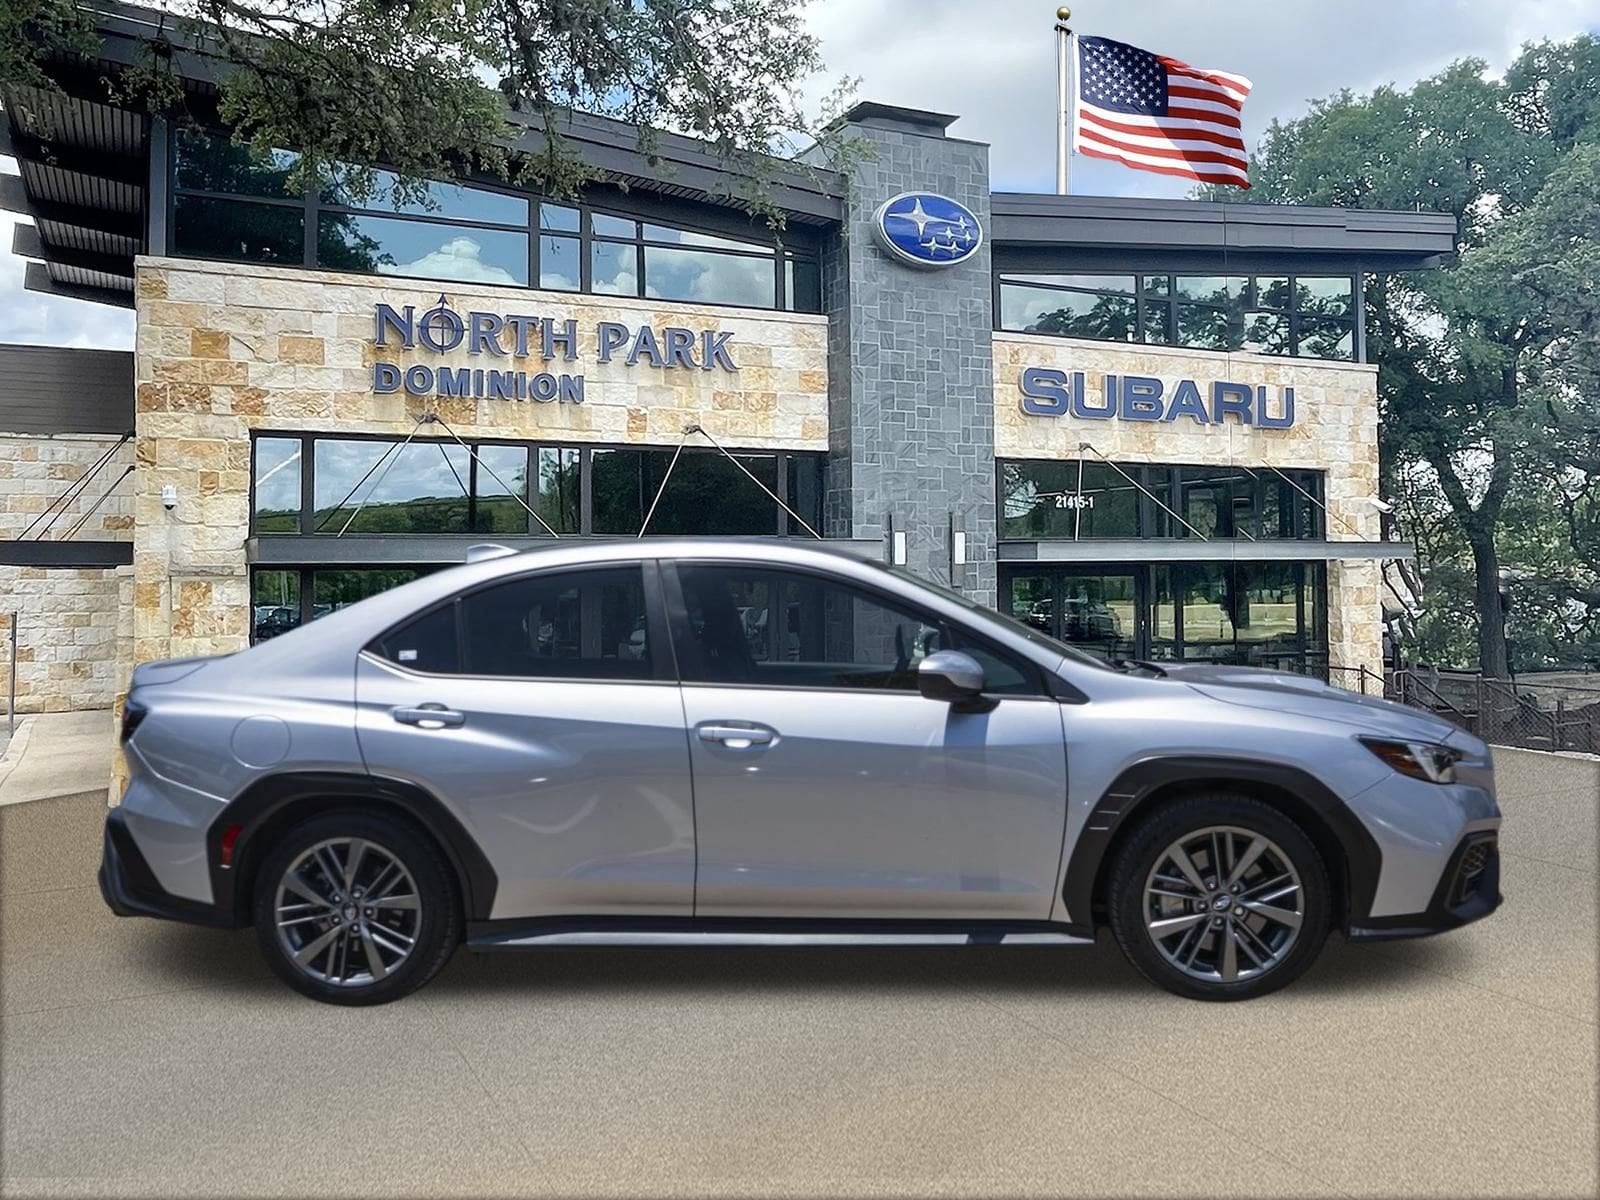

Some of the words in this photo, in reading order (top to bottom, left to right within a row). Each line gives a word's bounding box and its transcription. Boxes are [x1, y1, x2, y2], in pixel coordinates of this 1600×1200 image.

[375, 300, 579, 361] NORTH
[597, 321, 738, 373] PARK
[373, 362, 585, 404] DOMINION
[1019, 367, 1295, 429] SUBARU
